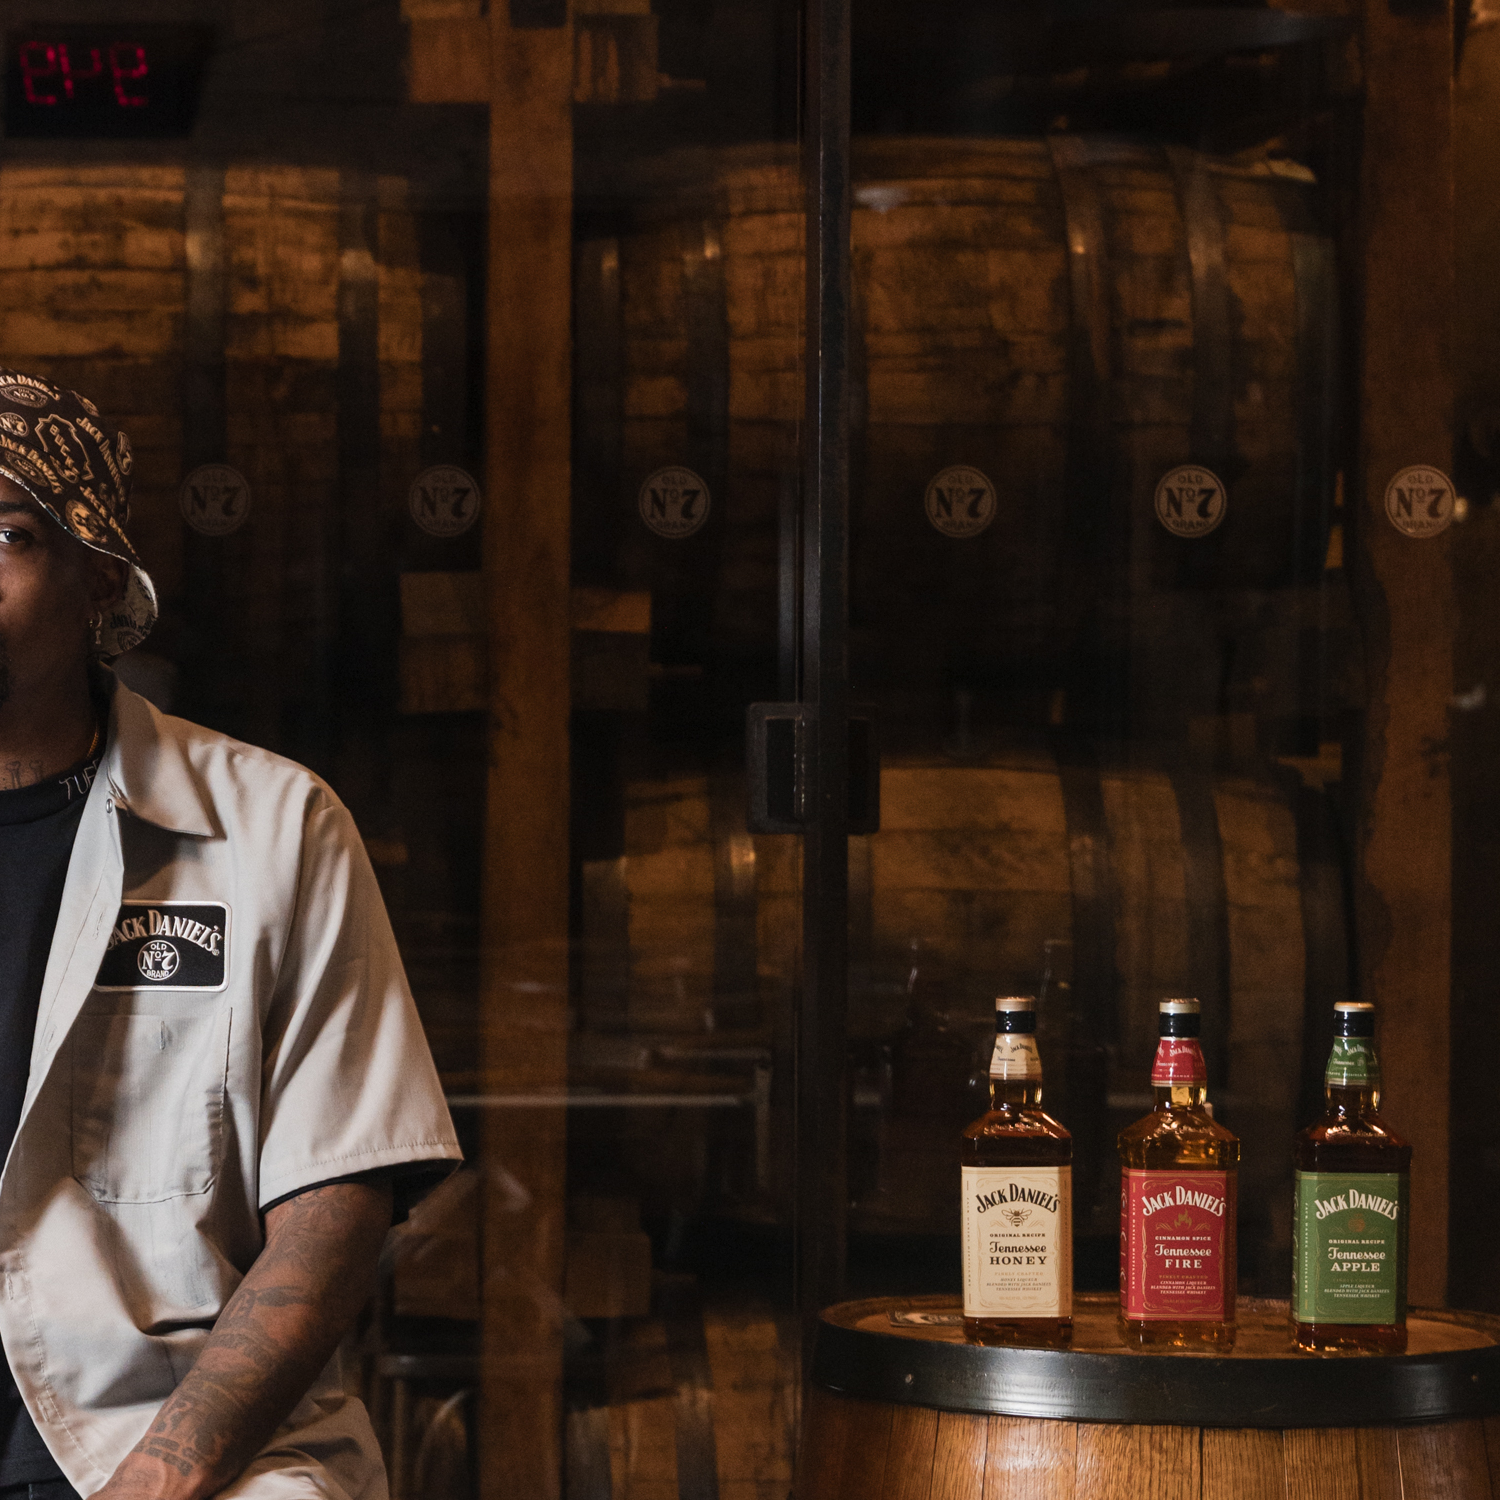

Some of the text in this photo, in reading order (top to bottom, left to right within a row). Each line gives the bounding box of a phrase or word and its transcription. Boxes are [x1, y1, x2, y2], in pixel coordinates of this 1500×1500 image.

[76, 417, 104, 443] JACK
[148, 909, 223, 952] DANIEL'S
[150, 941, 167, 951] OLD
[146, 970, 170, 978] BRAND
[975, 1183, 1061, 1214] JACK DANIEL'S
[1141, 1185, 1226, 1217] JACK DANIEL'S
[1314, 1188, 1399, 1220] JACK DANIEL'S
[989, 1241, 1046, 1253] Tennessee
[1154, 1243, 1212, 1256] Tennessee
[1328, 1247, 1386, 1260] Tennessee
[989, 1256, 1047, 1265] HONEY
[1165, 1259, 1202, 1268] FIRE
[1331, 1262, 1380, 1272] APPLE
